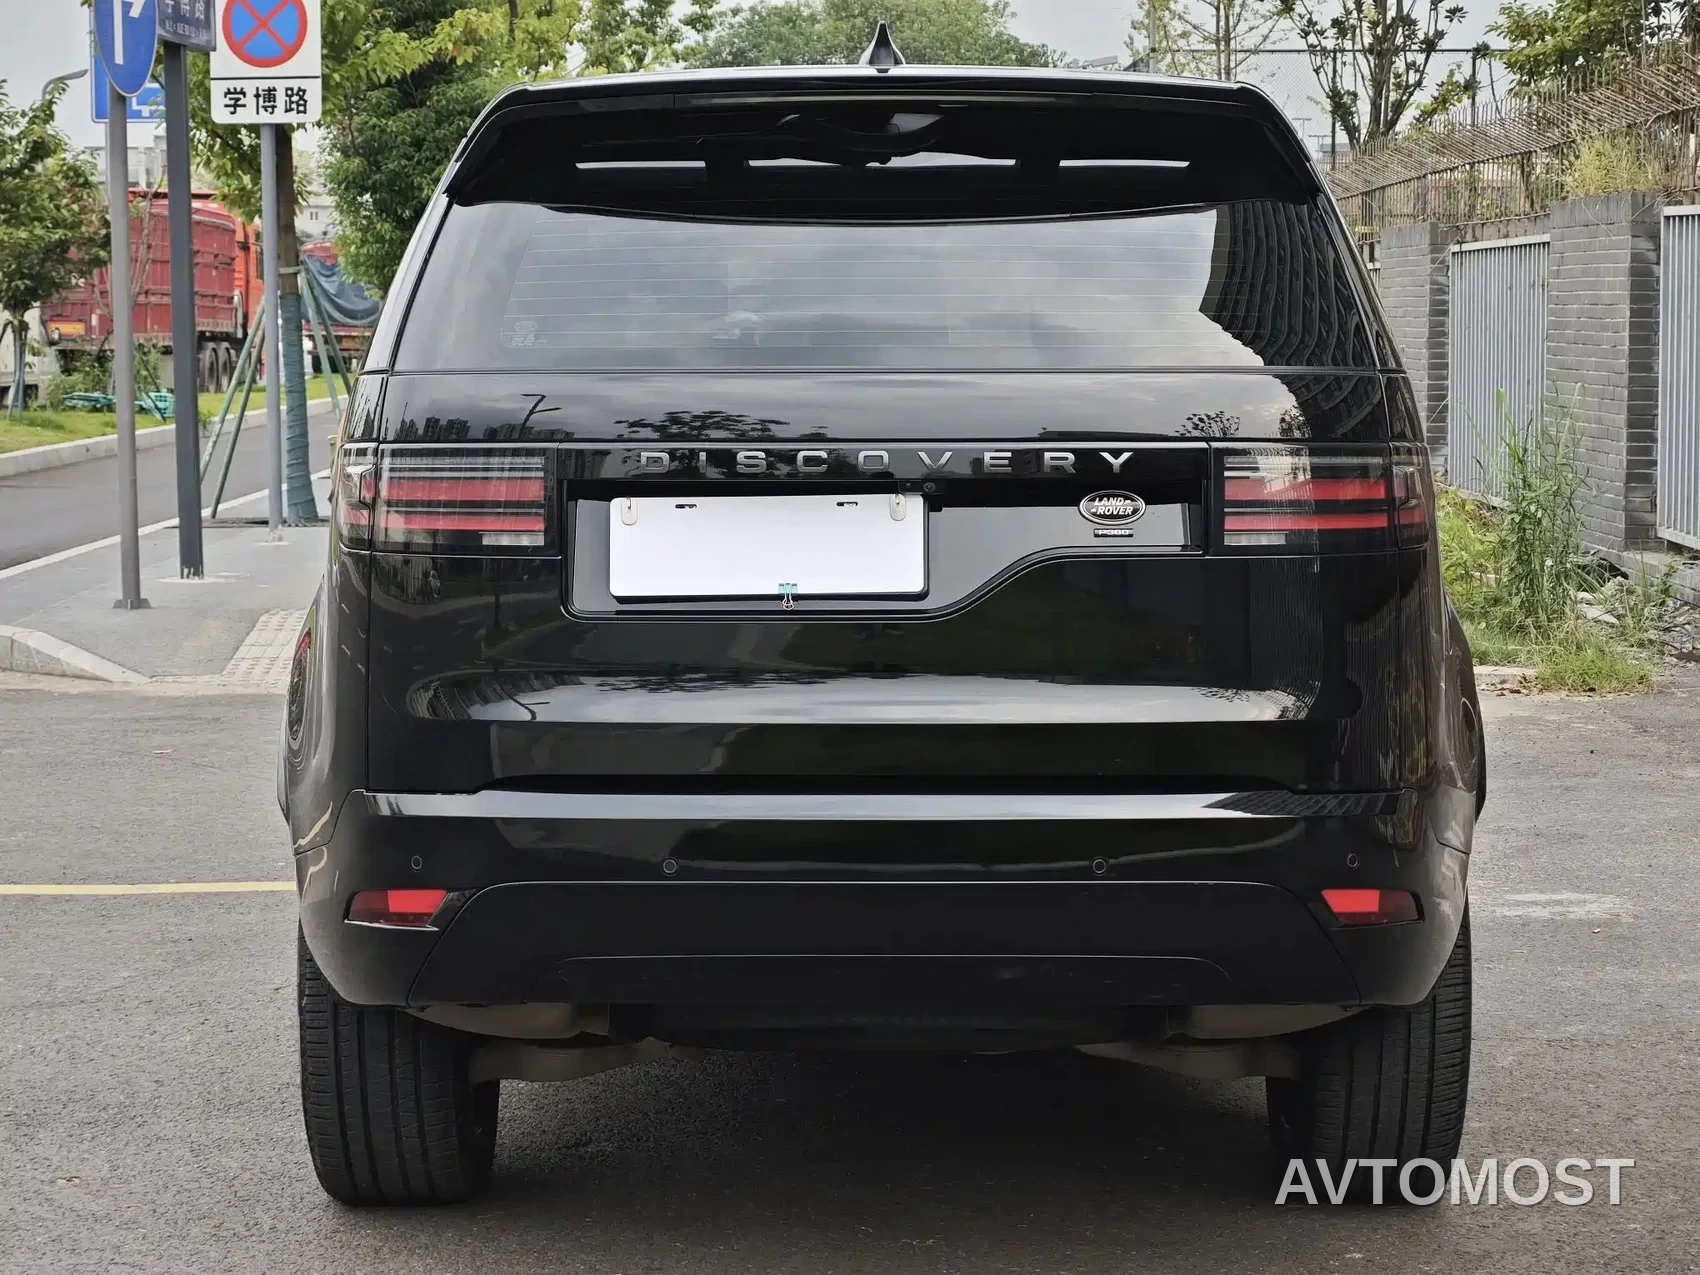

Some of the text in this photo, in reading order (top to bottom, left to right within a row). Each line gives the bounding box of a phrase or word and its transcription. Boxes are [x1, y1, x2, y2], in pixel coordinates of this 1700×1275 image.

[223, 86, 309, 115] 学博路
[640, 450, 1134, 474] DISCOVERY
[1094, 497, 1124, 506] LAND
[1096, 506, 1133, 515] ROVER
